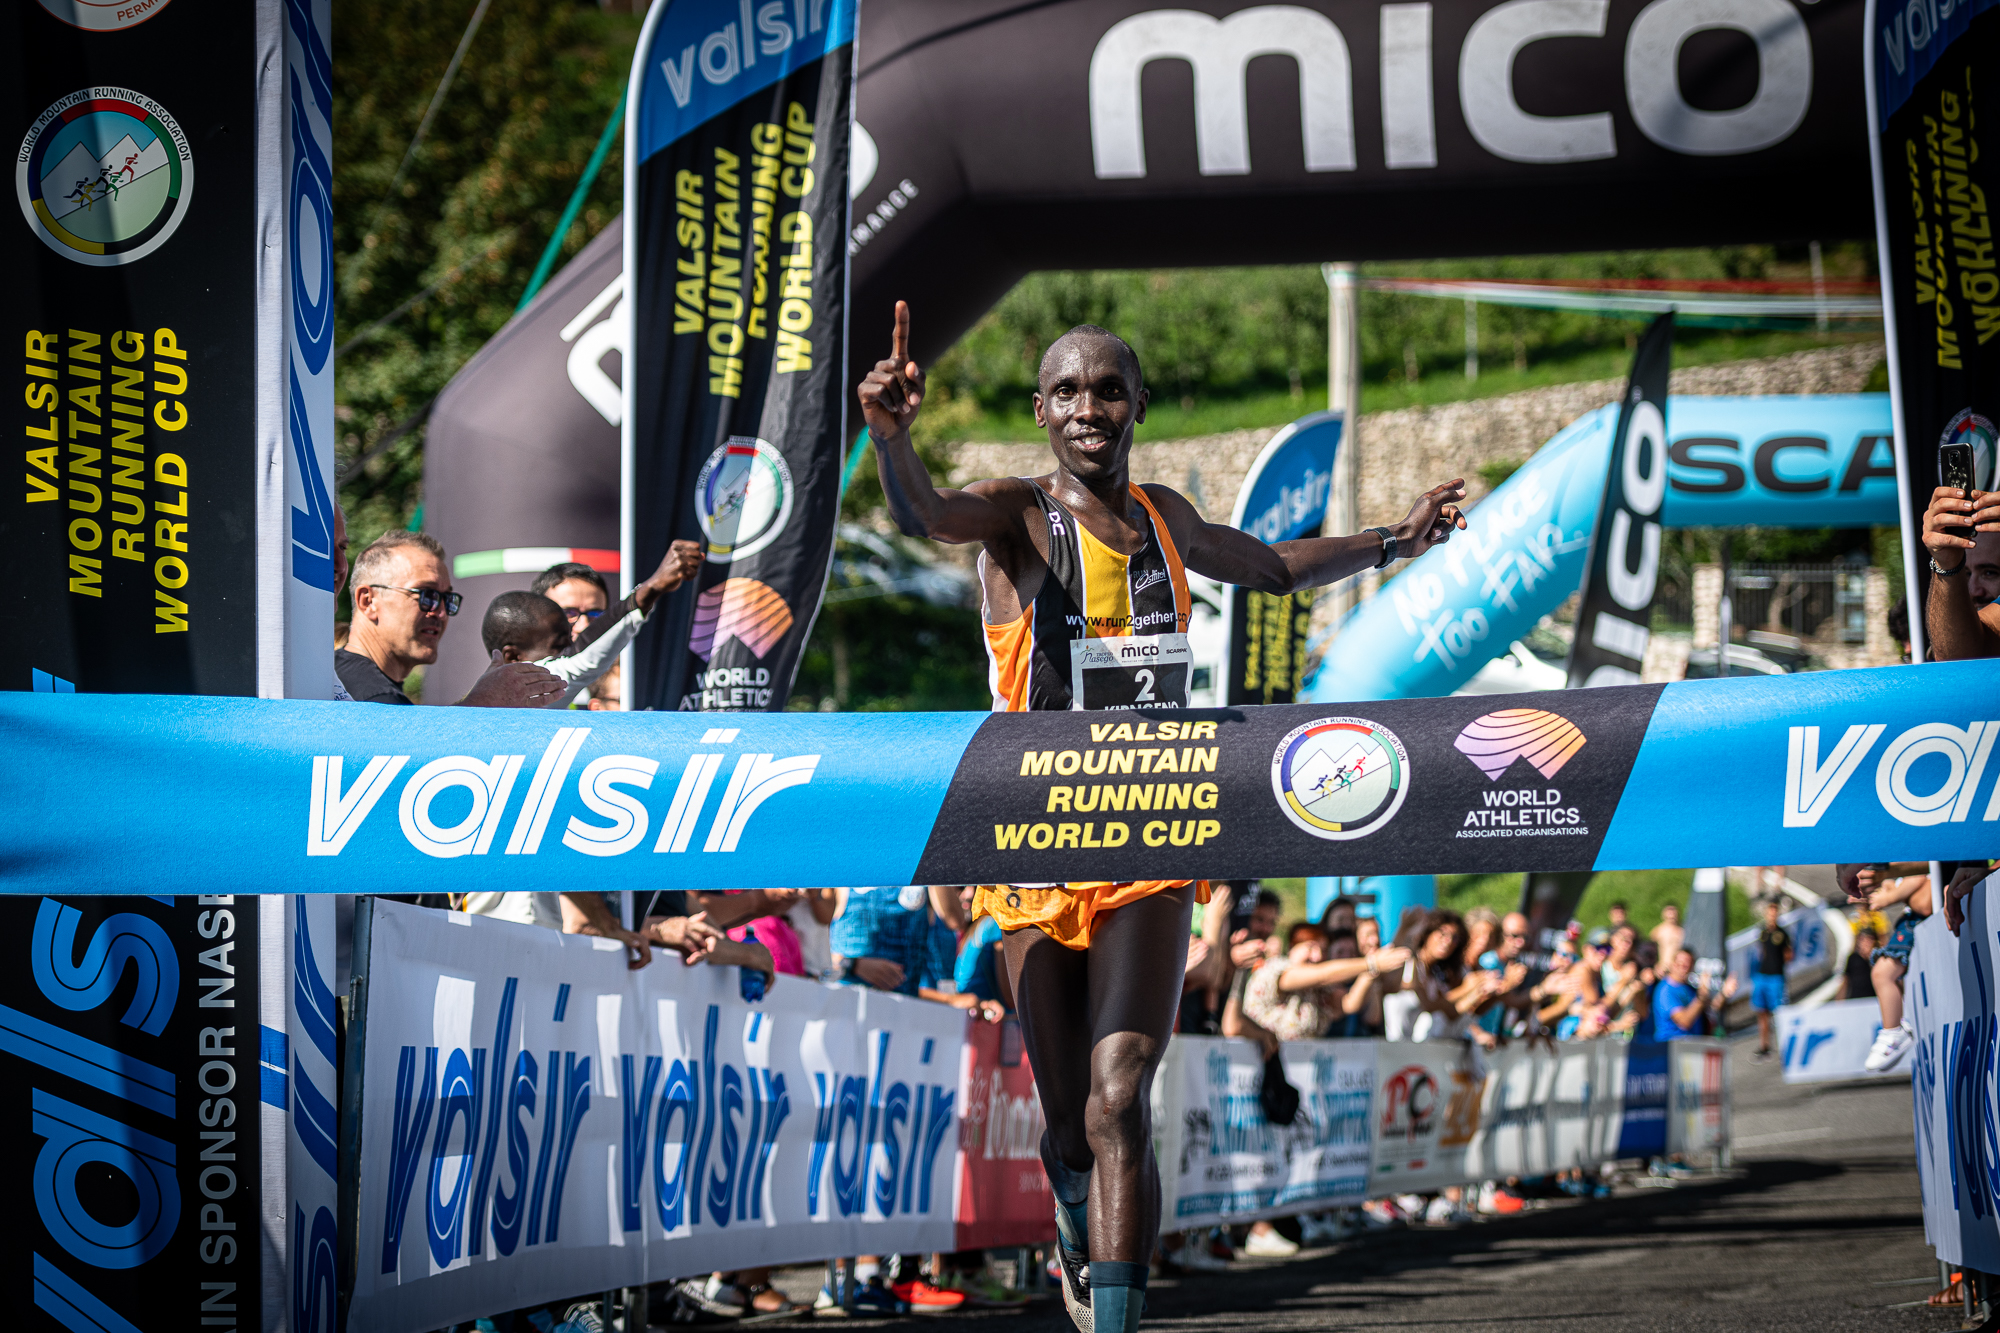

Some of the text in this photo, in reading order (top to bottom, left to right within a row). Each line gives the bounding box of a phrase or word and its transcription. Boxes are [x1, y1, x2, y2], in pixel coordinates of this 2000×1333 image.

[116, 0, 158, 22] PERM
[18, 87, 191, 163] WORLD MOUNTAIN RUNNING ASSOCIATION
[674, 169, 705, 334] VALSIR
[707, 147, 744, 398] MOUNTAIN
[777, 101, 817, 375] WORLD CUP
[25, 329, 59, 503] VALSIR
[68, 328, 102, 598] MOUNTAIN
[110, 330, 145, 562] RUNNING
[153, 327, 189, 634] WORLD CUP
[1090, 721, 1218, 742] VALSIR
[1134, 668, 1155, 702] 2
[307, 727, 821, 858] valsir
[1020, 747, 1220, 776] MOUNTAIN
[1274, 717, 1406, 765] WORLD MOUNTAIN RUNNING ASSOCIATION
[994, 819, 1221, 850] WORLD CUP
[1046, 782, 1219, 812] RUNNING
[1455, 827, 1589, 838] ASSOCIATED ORGANISATIONS
[1463, 807, 1580, 827] ATHLETICS
[1483, 789, 1561, 807] WORLD
[199, 1026, 236, 1264] SPONSOR
[381, 976, 591, 1275] valsir
[622, 1004, 791, 1233] valsir
